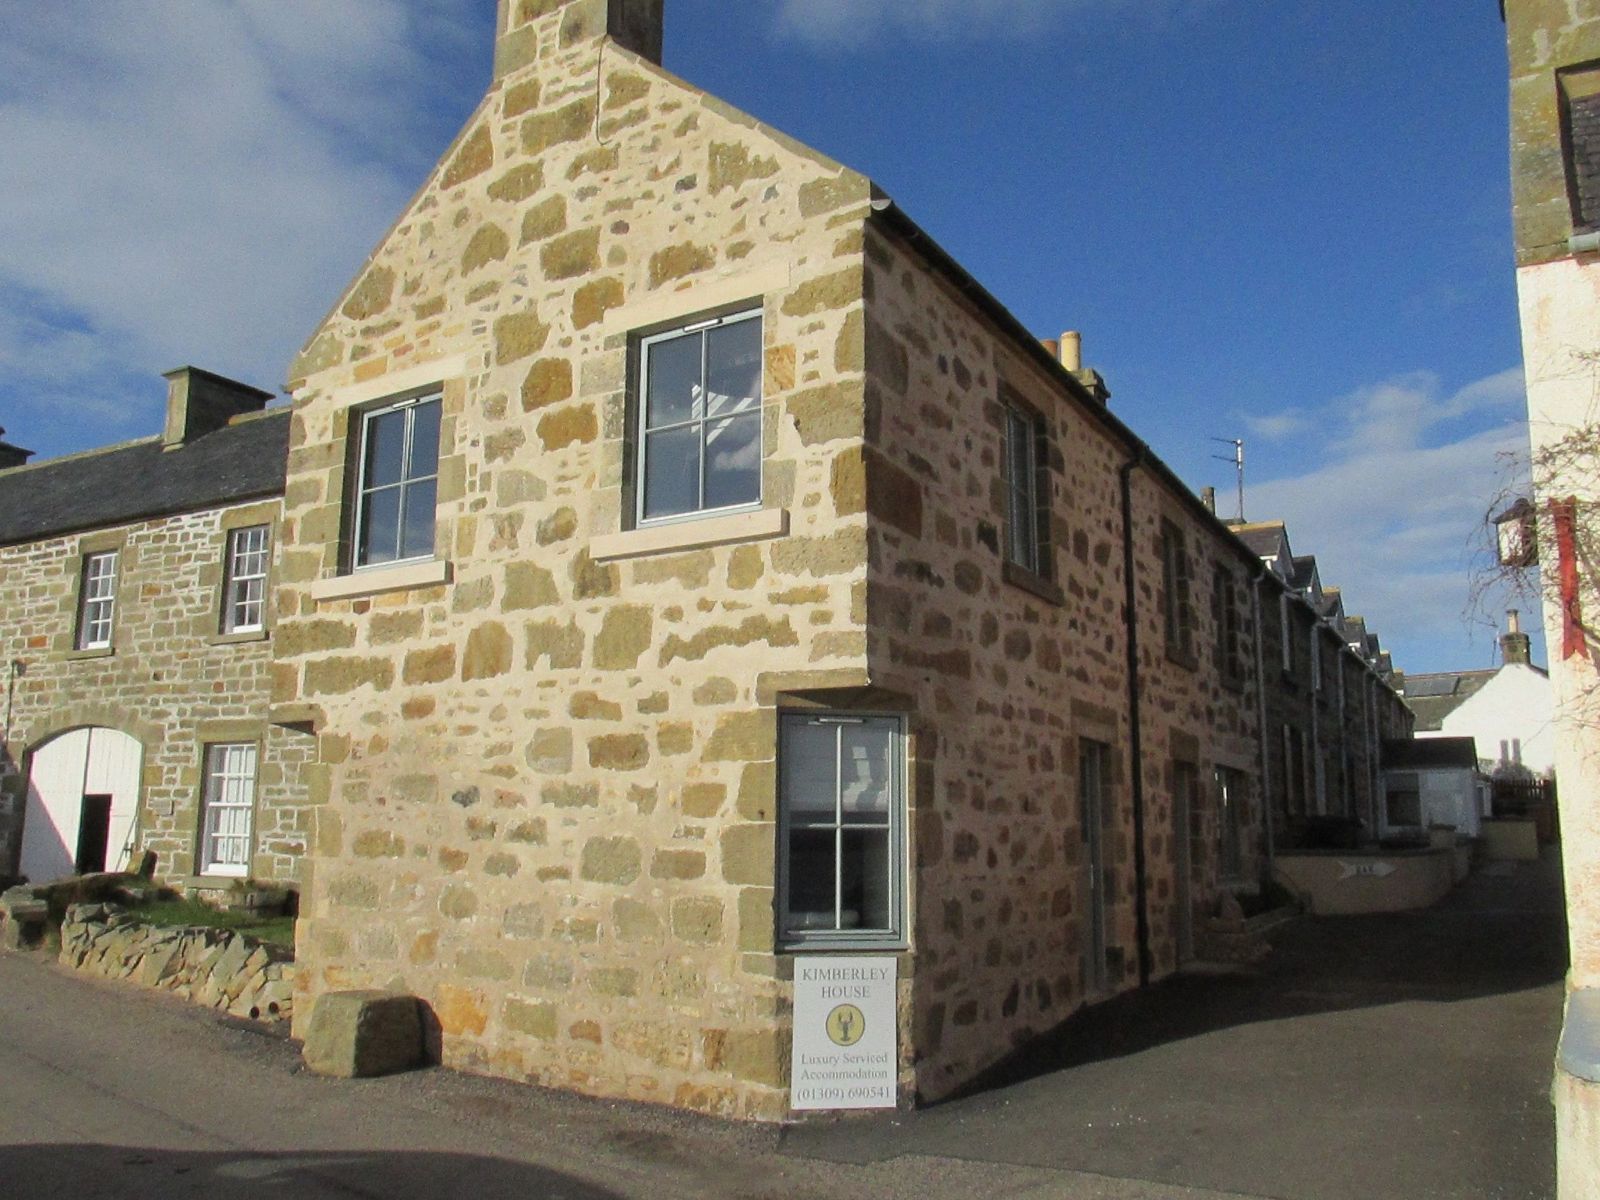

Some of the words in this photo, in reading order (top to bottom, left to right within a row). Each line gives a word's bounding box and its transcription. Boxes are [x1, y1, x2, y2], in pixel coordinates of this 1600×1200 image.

[803, 967, 888, 980] KIMBERLEY
[822, 985, 871, 998] HOUSE
[801, 1053, 840, 1066] Luxury
[843, 1052, 888, 1064] Serviced
[801, 1068, 888, 1080] Accommodation
[797, 1087, 845, 1101] (01309)
[848, 1086, 889, 1100] 690541
